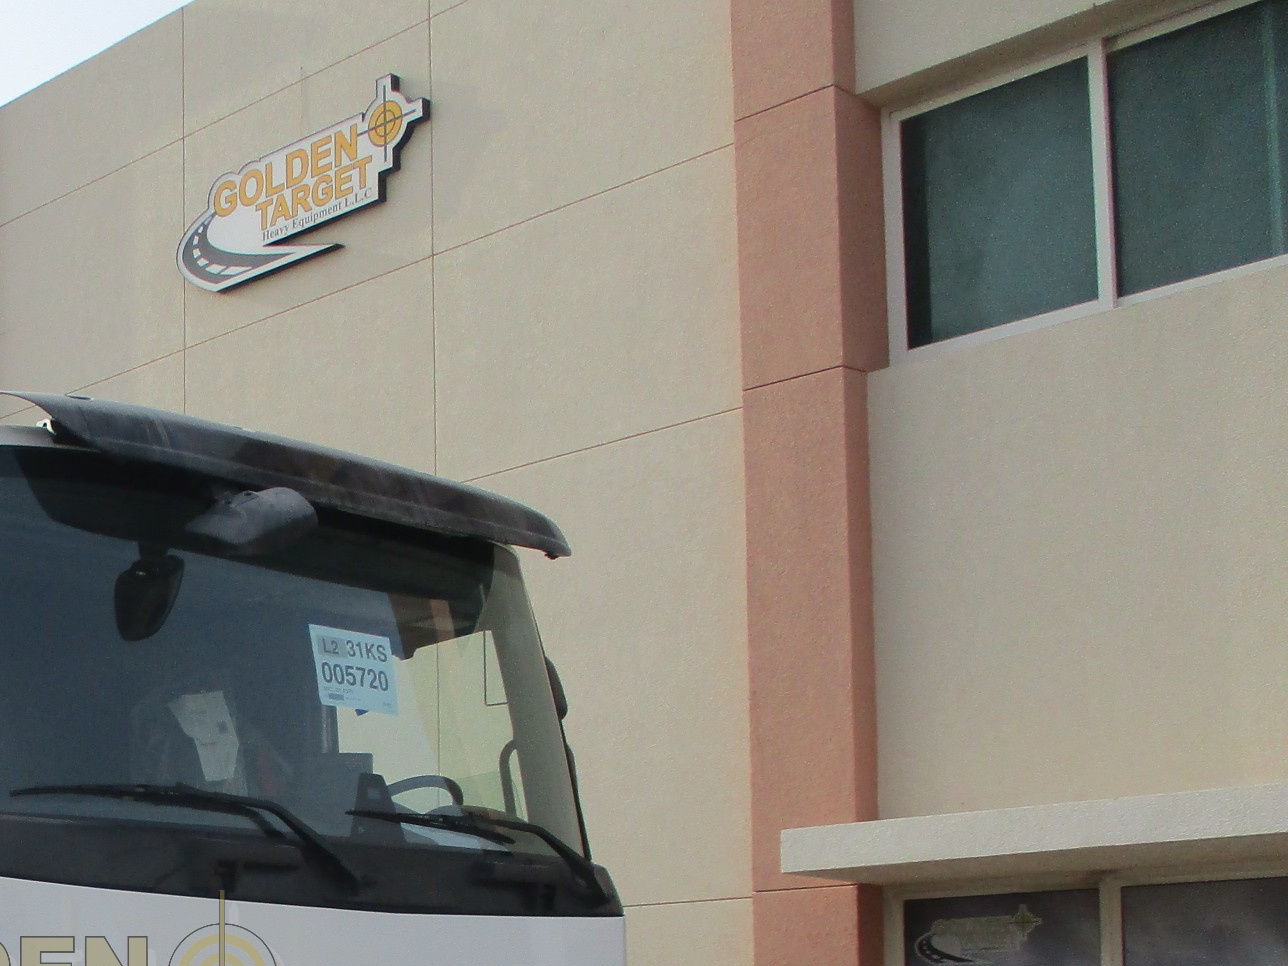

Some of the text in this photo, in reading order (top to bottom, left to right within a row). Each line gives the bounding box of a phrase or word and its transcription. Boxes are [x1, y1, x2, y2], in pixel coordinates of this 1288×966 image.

[213, 123, 358, 217] GOLDEN
[255, 154, 373, 230] TARGET
[262, 222, 290, 242] Heavy
[292, 201, 343, 229] Equipment
[322, 638, 388, 662] L2 31KS
[321, 661, 389, 692] 005720
